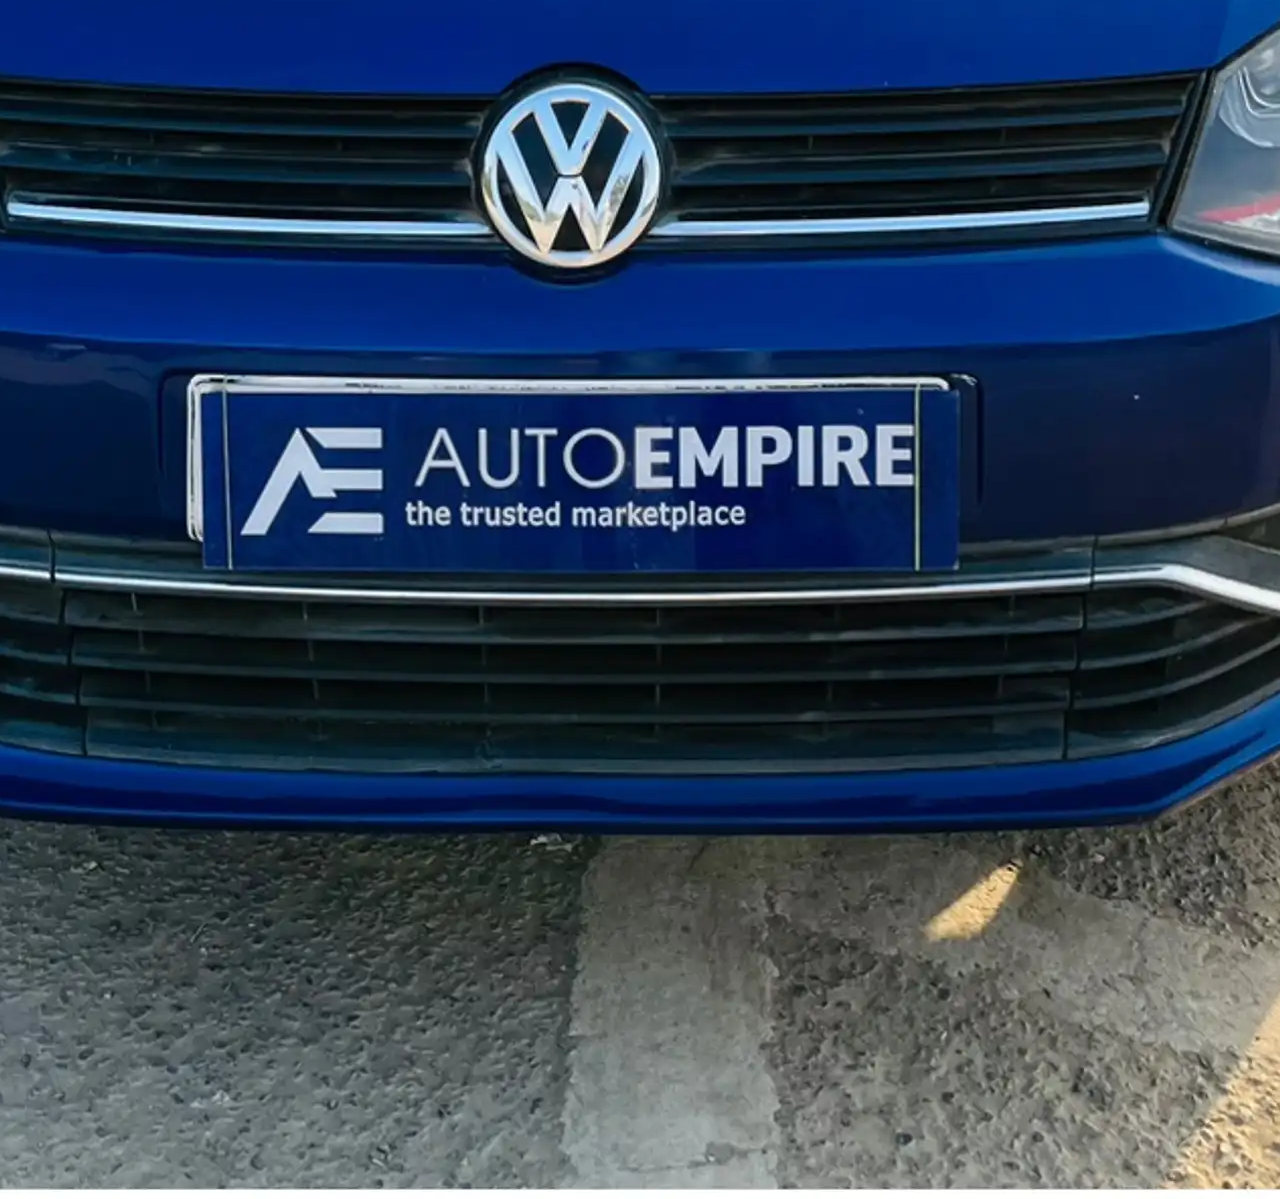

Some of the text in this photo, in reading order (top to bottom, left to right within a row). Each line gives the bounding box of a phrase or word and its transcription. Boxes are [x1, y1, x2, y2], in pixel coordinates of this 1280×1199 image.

[414, 424, 916, 489] AUTOEMPIRE
[405, 501, 746, 532] the trusted marketplace
